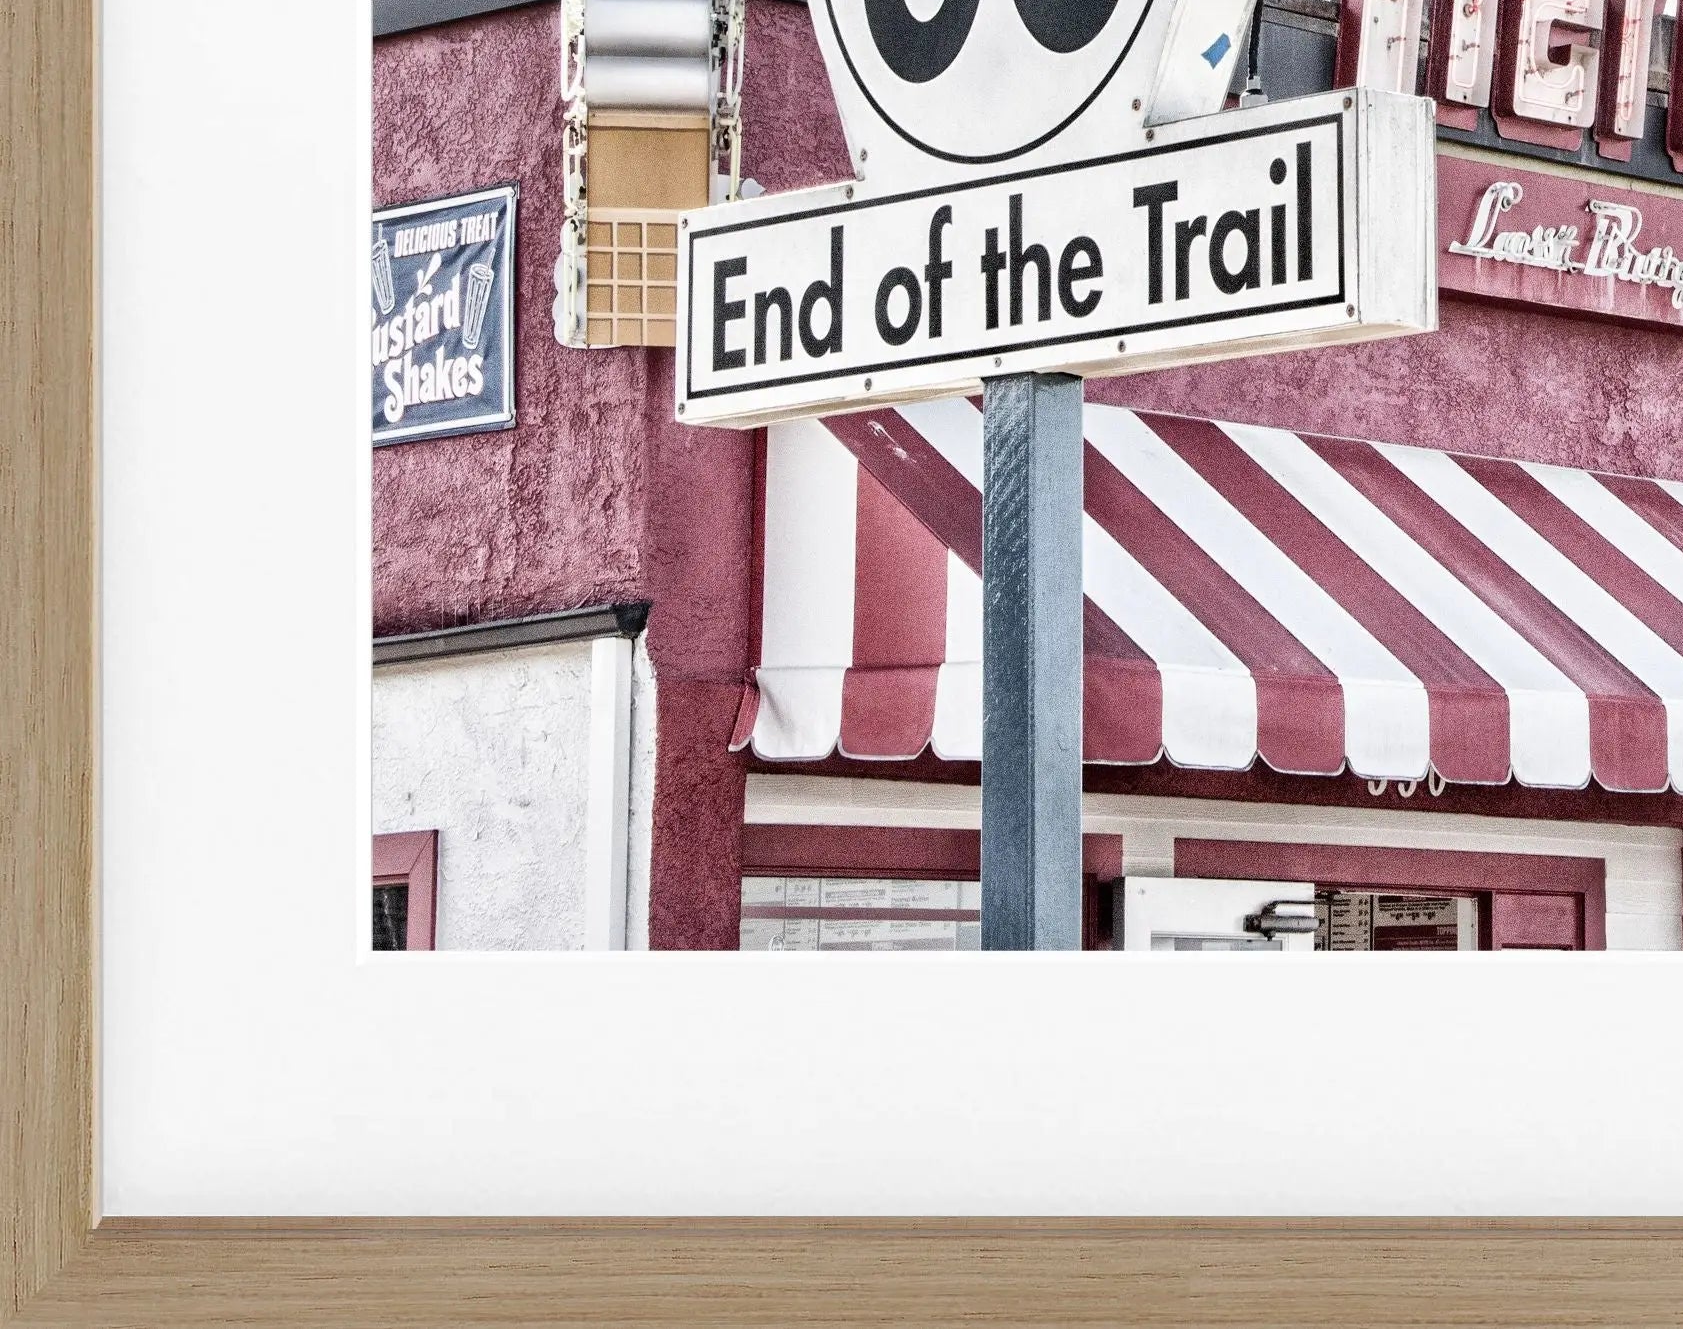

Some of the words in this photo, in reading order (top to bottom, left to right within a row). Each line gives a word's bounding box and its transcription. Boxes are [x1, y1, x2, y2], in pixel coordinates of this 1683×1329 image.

[394, 219, 457, 257] DELICIOUS
[460, 211, 499, 245] TREAT
[712, 226, 844, 371] End
[875, 205, 952, 346] of
[981, 193, 1104, 330] the
[1133, 141, 1314, 305] Trail
[1449, 182, 1584, 273] Last
[372, 273, 461, 367] ustard
[384, 345, 484, 423] Shakes
